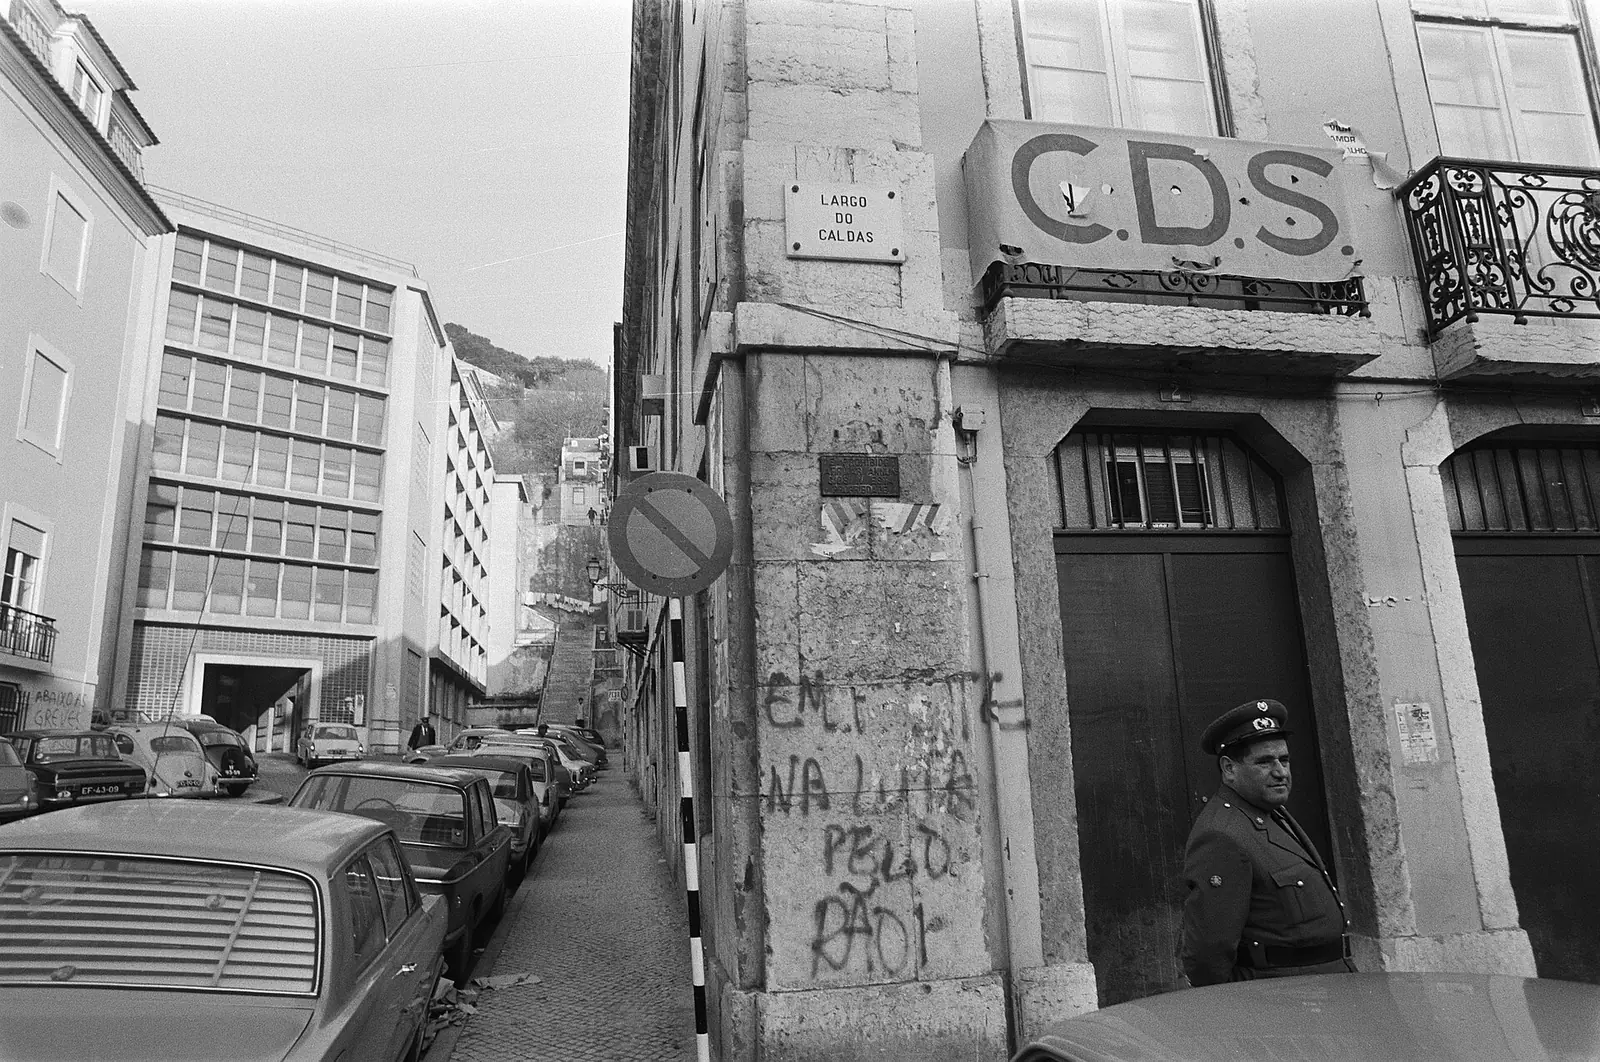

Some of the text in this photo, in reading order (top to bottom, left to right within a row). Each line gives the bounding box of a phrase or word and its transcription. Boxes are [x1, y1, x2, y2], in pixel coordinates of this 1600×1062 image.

[820, 194, 867, 208] LARGO
[1011, 133, 1354, 257] C.D.S.
[835, 212, 853, 225] DO
[818, 229, 874, 243] CALDAS
[768, 754, 831, 817] NA
